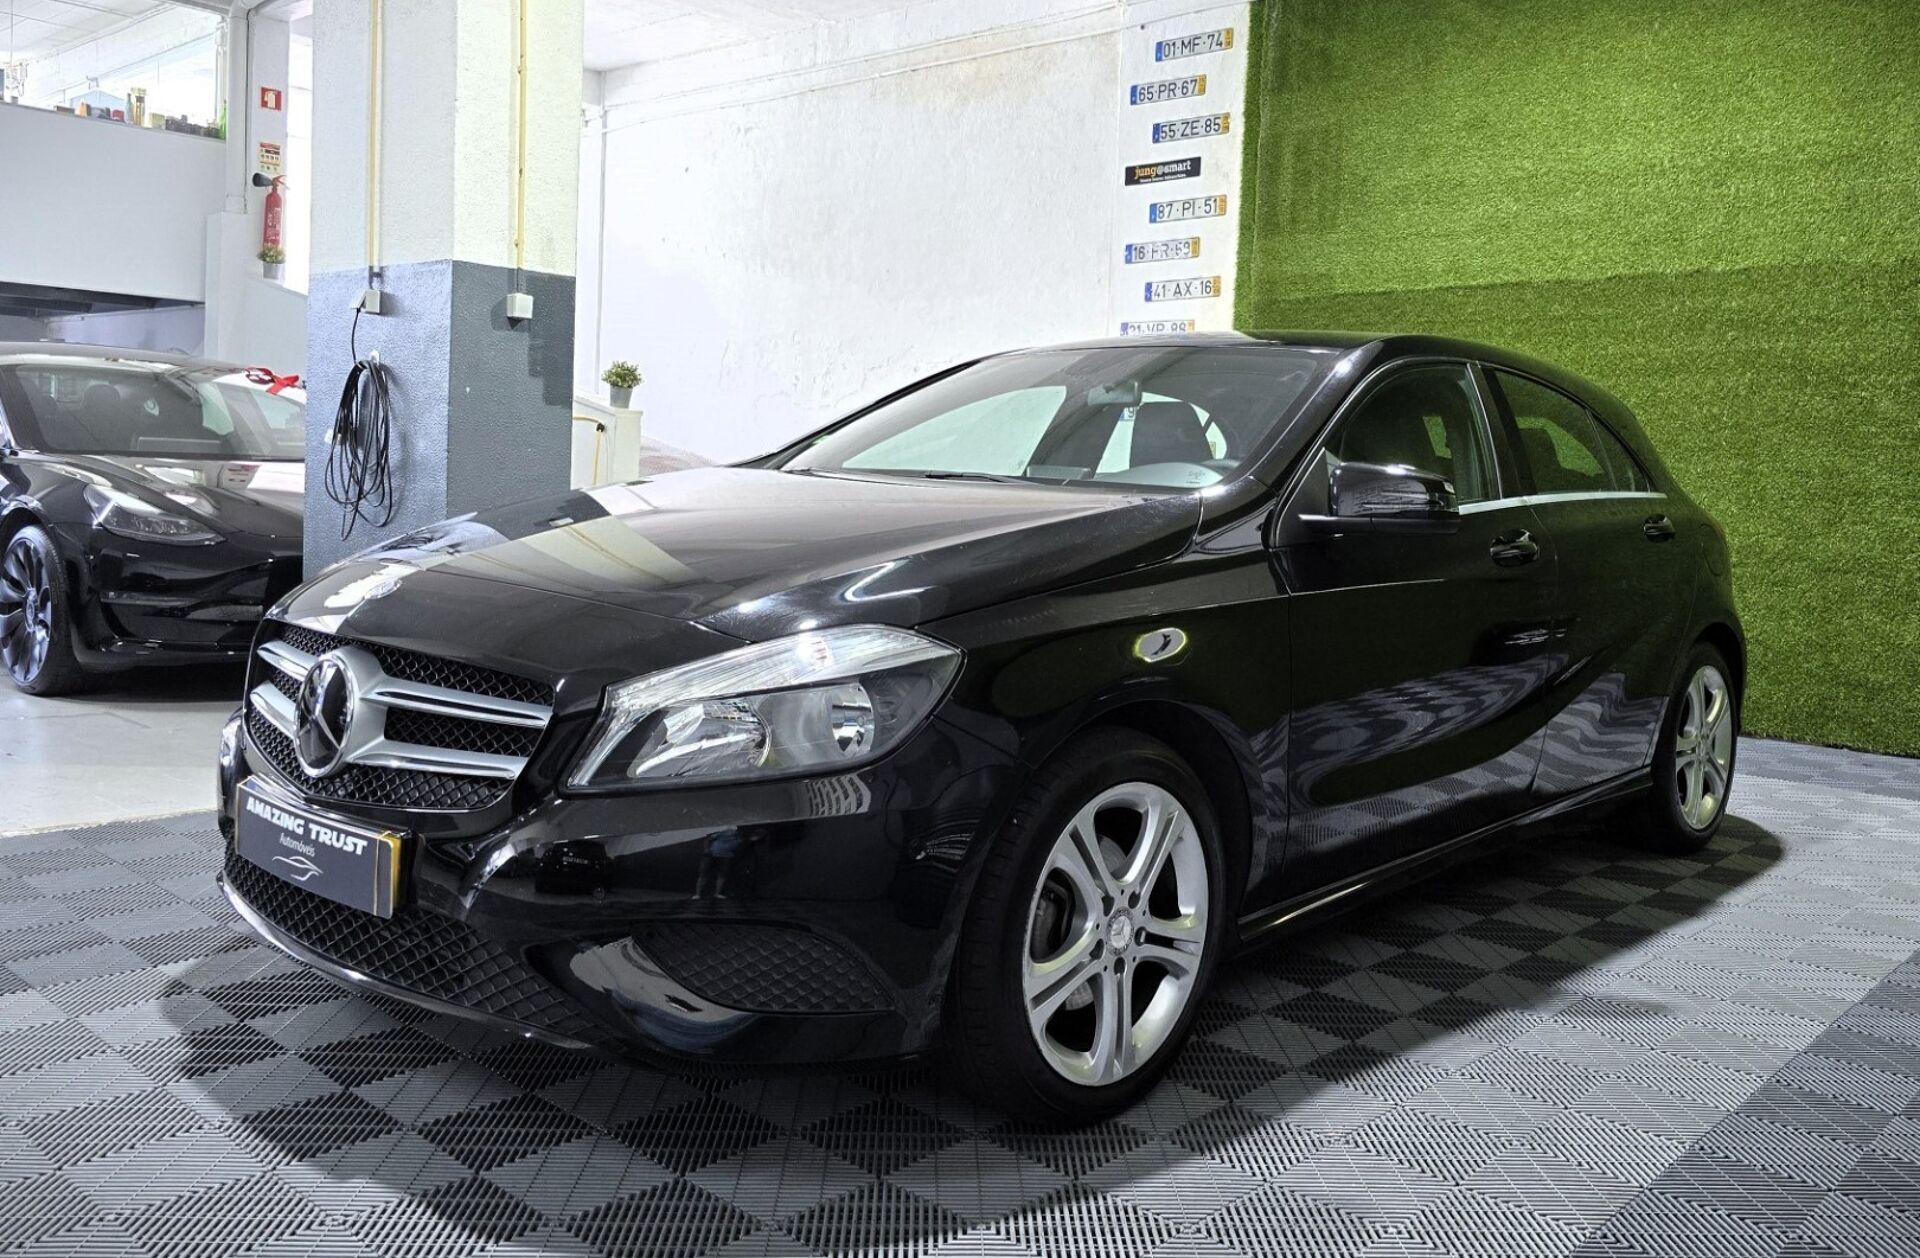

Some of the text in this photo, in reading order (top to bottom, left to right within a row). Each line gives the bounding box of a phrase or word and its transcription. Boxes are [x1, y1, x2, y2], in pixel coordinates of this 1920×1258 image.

[246, 796, 368, 856] AMAZING TRUST
[279, 832, 316, 857] Automóveis
